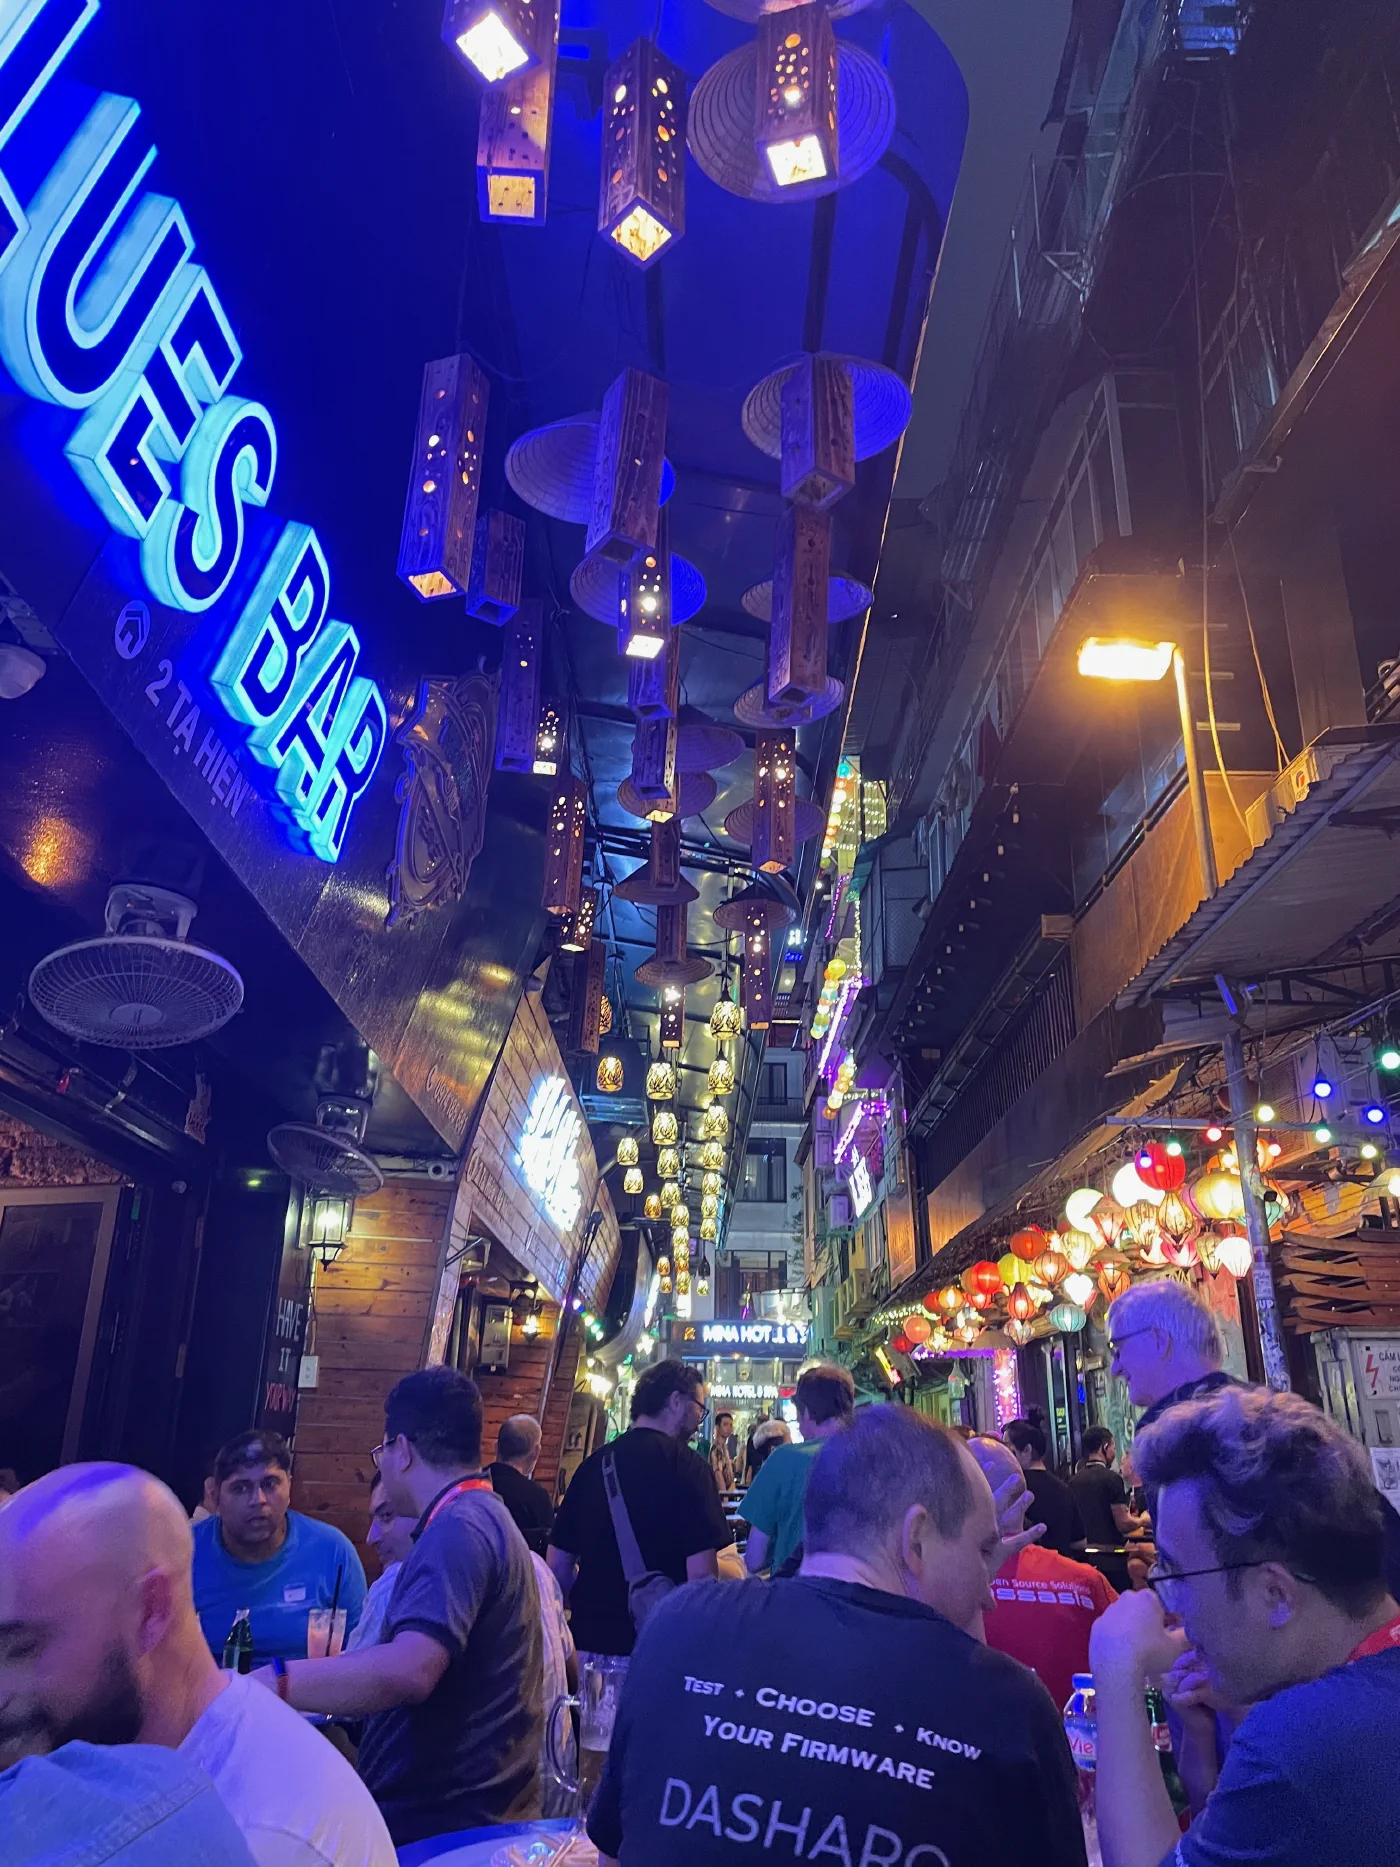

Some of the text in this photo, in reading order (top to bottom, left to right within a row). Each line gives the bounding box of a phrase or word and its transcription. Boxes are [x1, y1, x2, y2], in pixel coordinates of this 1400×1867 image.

[144, 658, 173, 708] 2
[165, 679, 201, 755] TẠ
[209, 520, 388, 864] BAR
[276, 1296, 304, 1342] HAVE
[755, 1687, 876, 1728] CHOOSE
[703, 1714, 936, 1790] YOUR FIRMWARE
